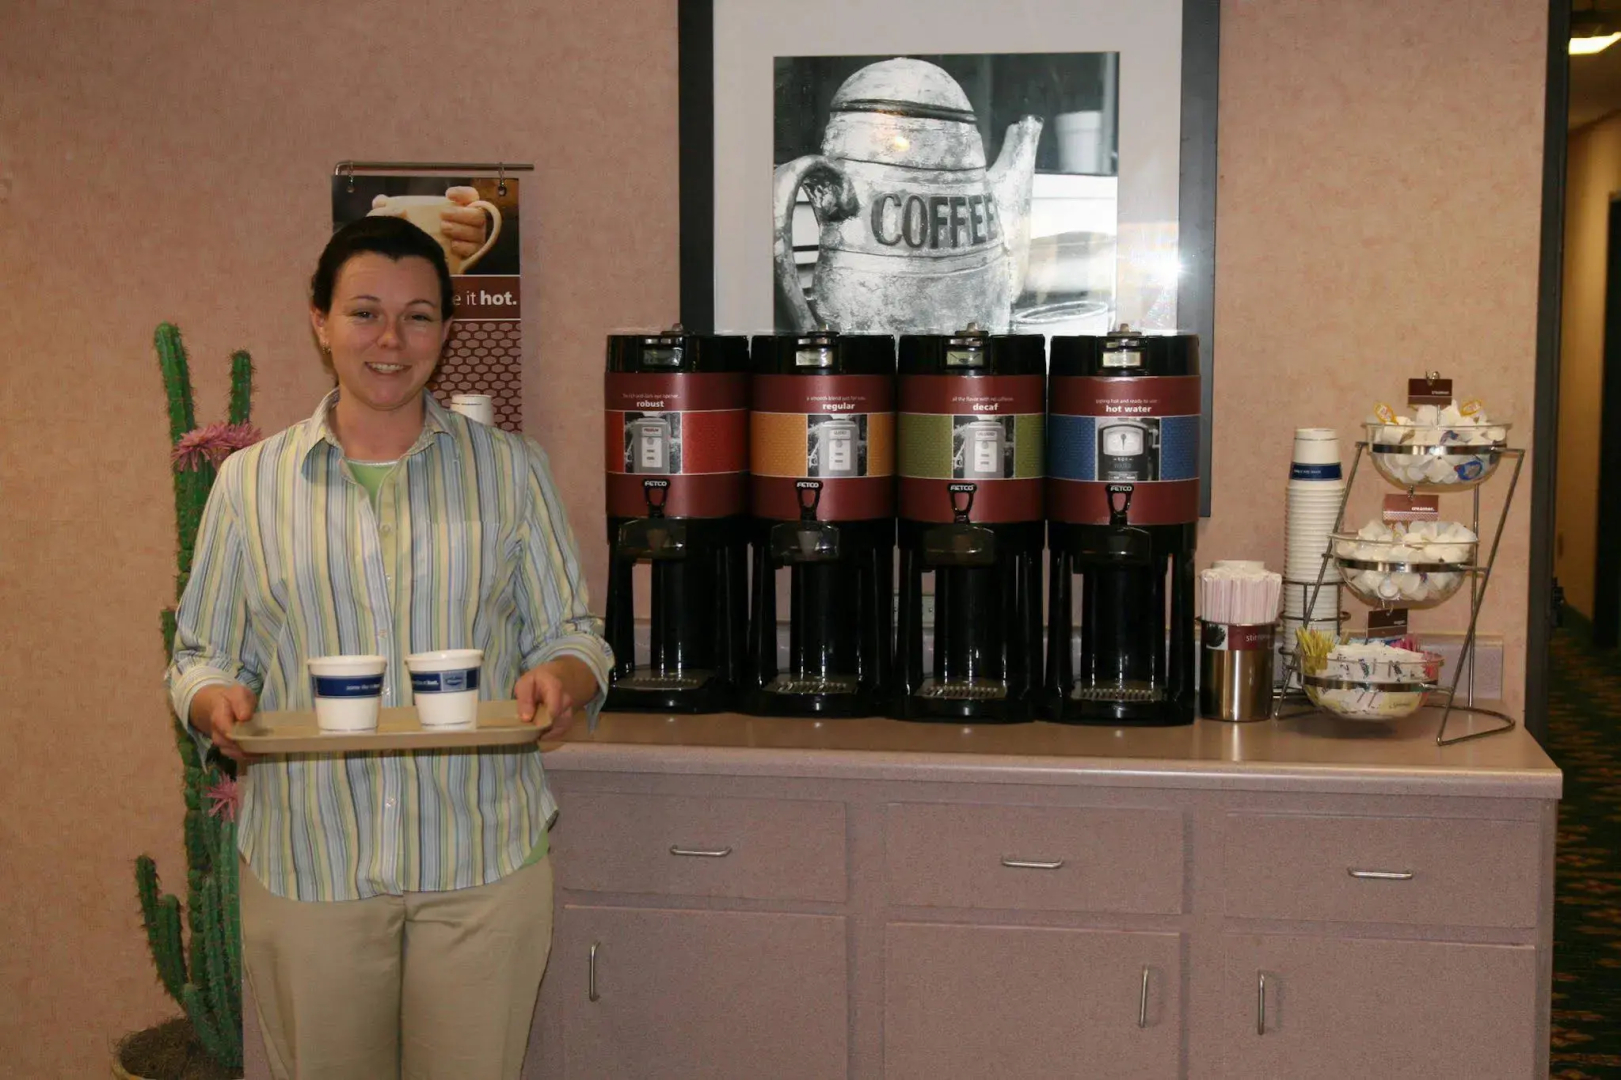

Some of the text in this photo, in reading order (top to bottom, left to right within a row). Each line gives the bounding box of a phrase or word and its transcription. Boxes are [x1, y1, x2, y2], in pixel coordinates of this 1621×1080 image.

[870, 193, 998, 249] COFFEE
[466, 290, 477, 306] it
[480, 290, 517, 306] hot.
[822, 402, 856, 411] regular
[972, 402, 999, 411] decaf
[1105, 405, 1152, 413] hot water
